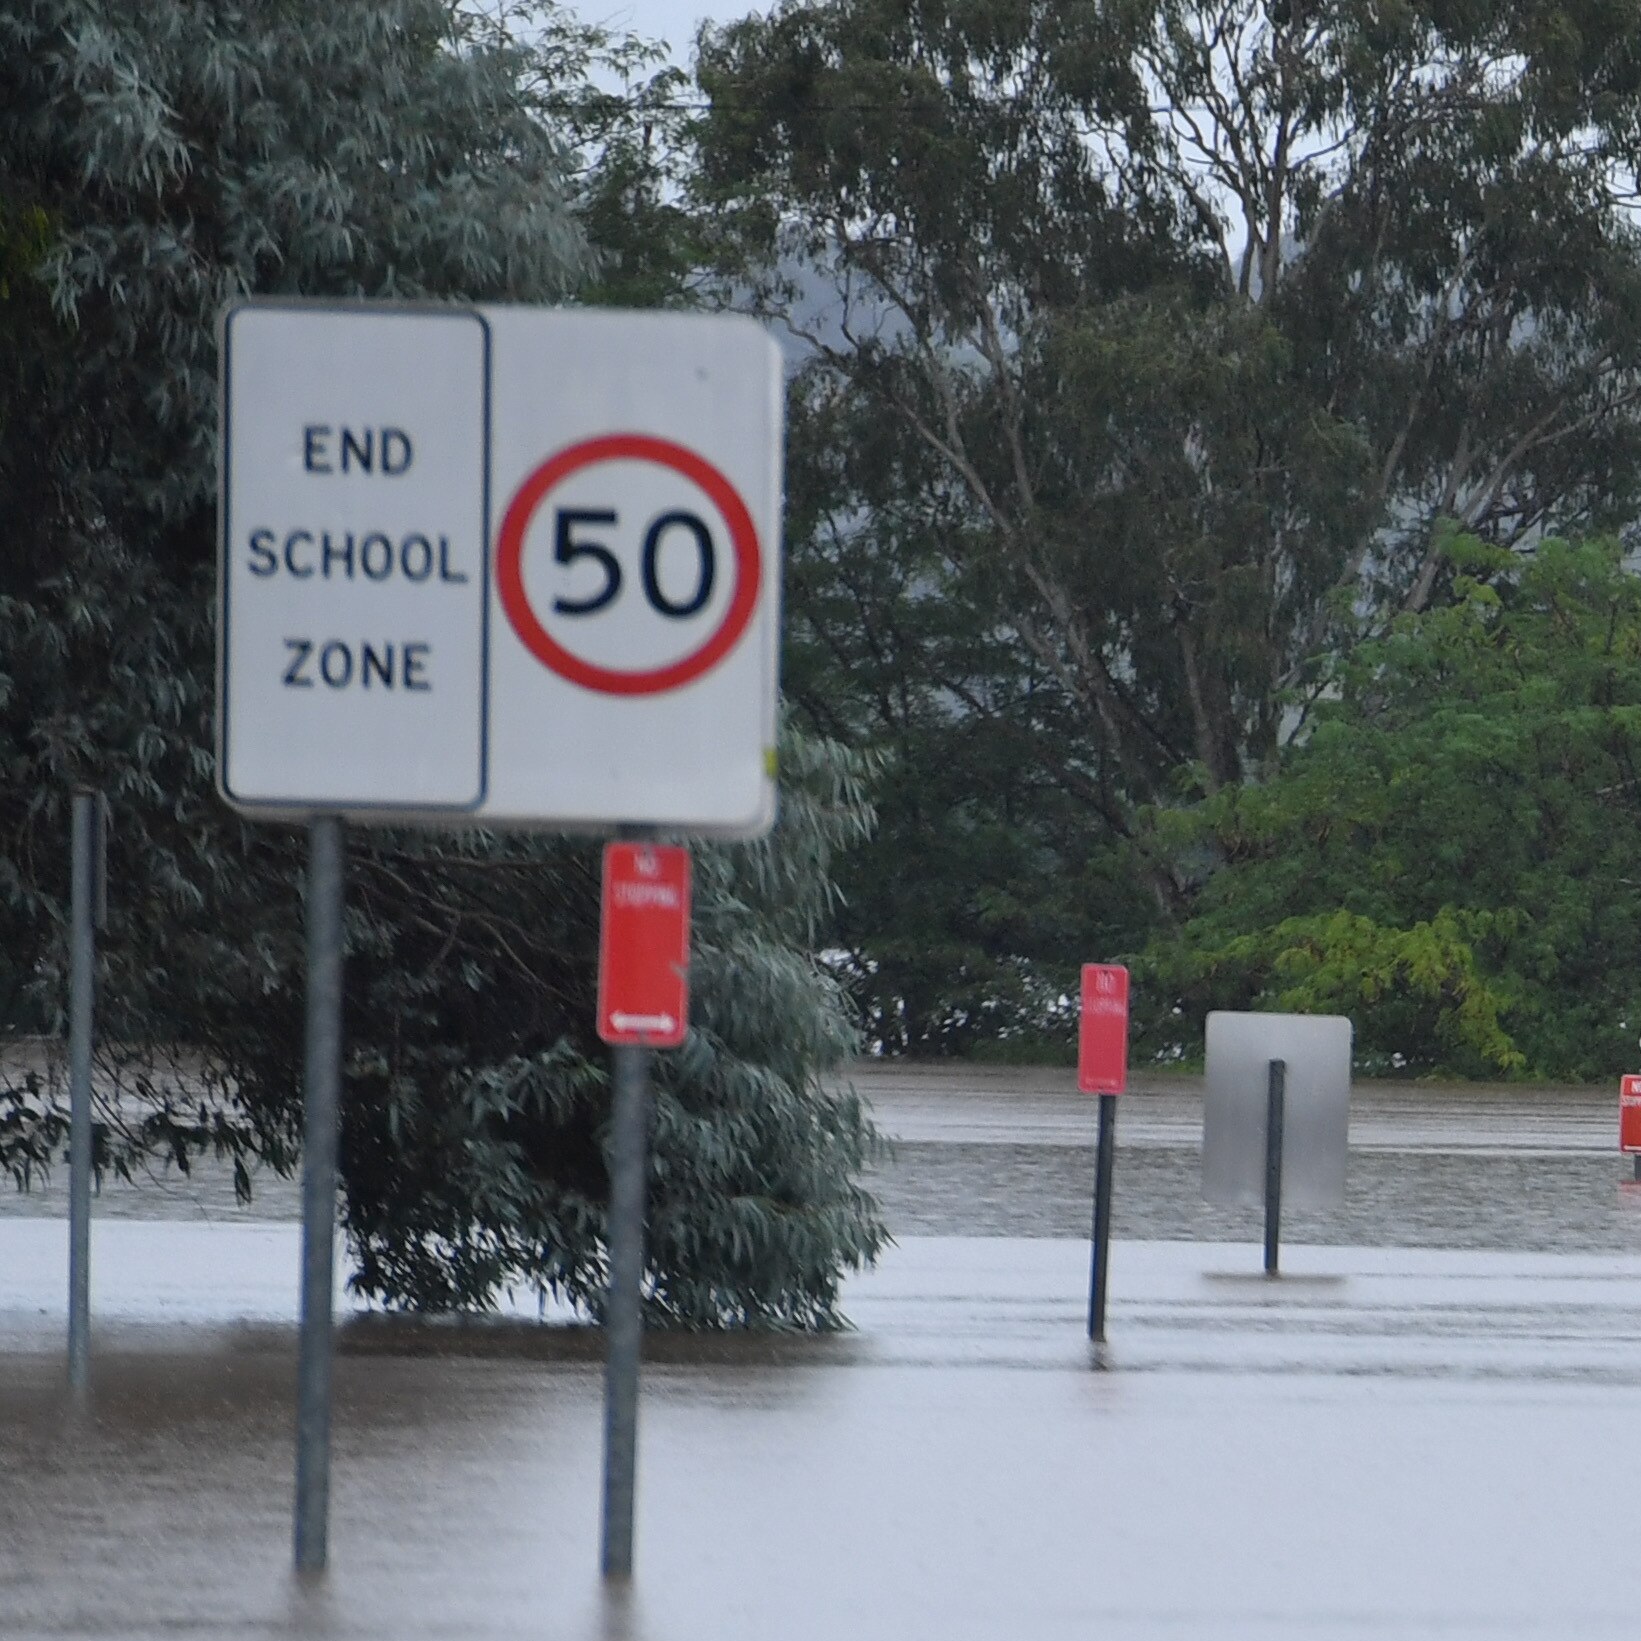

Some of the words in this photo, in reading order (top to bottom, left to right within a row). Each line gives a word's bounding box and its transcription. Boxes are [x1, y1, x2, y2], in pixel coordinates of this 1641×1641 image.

[303, 425, 415, 476] END
[246, 529, 470, 585] SCHOOL
[552, 508, 716, 620] 50
[282, 637, 433, 692] ZONE
